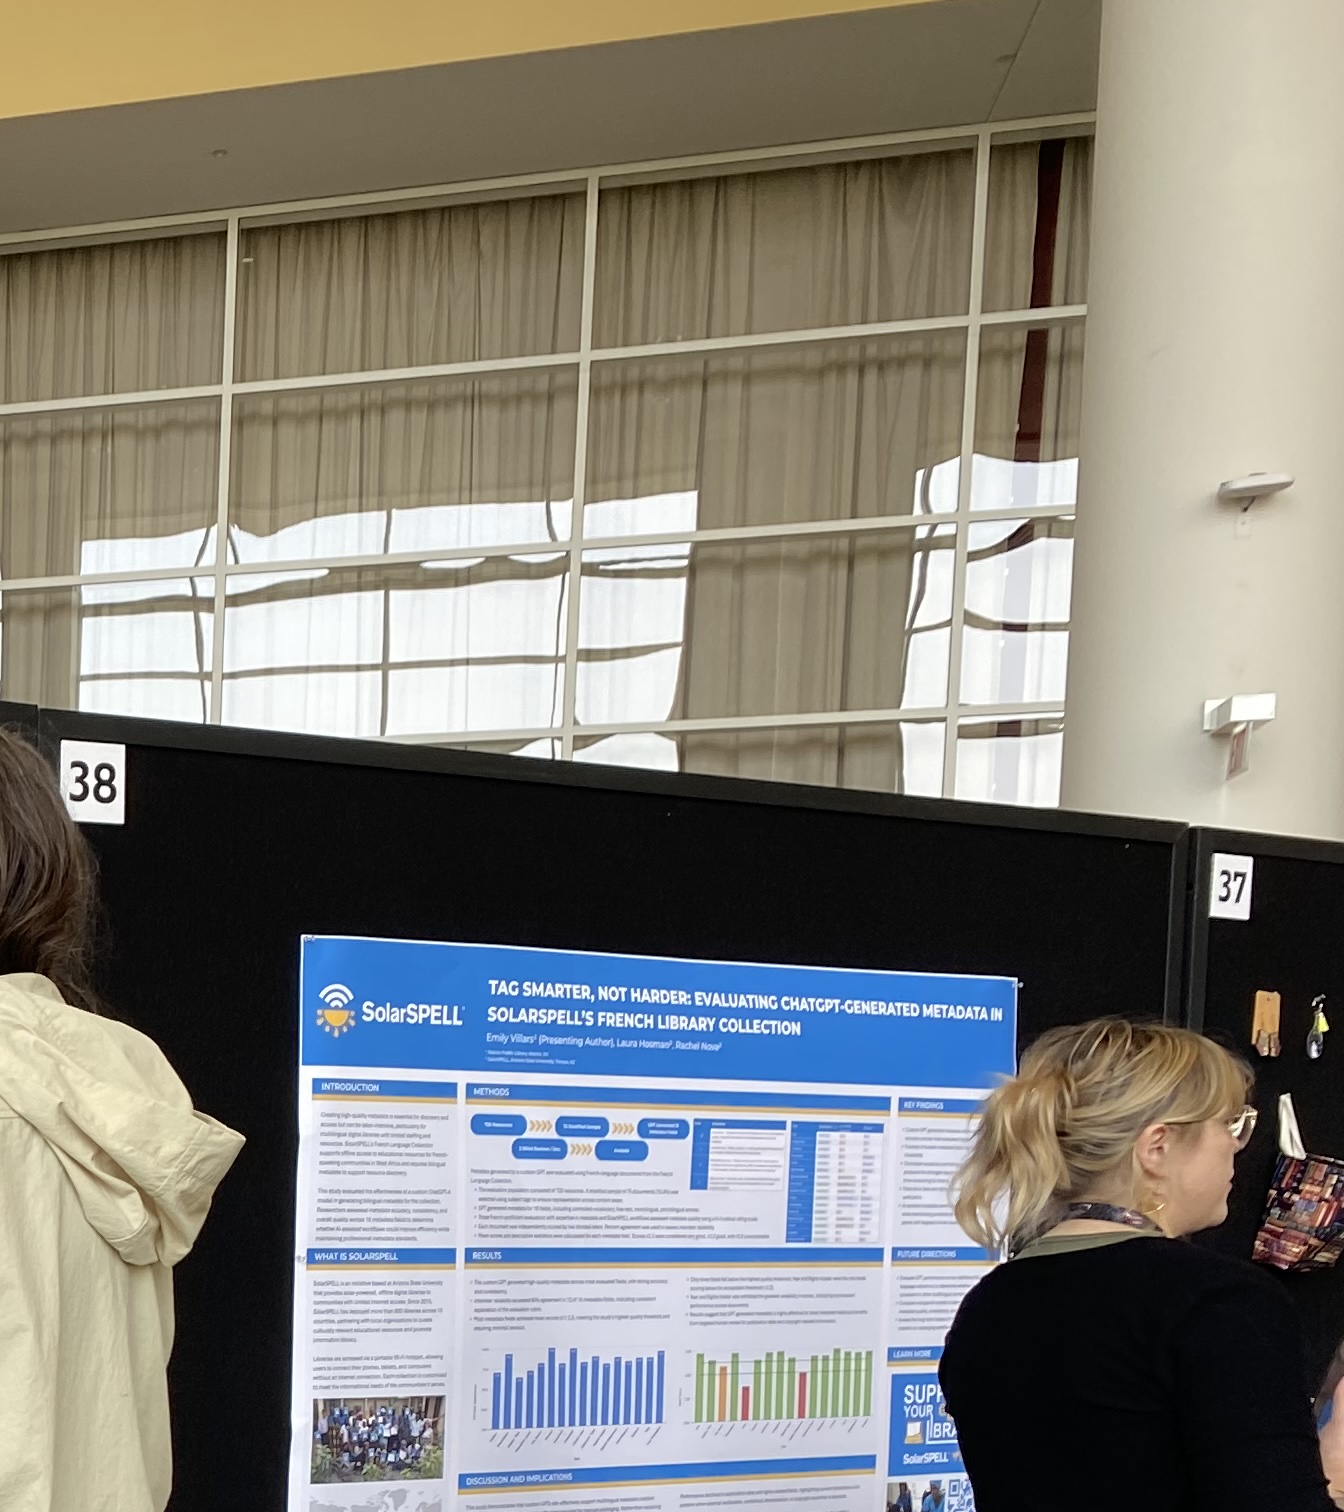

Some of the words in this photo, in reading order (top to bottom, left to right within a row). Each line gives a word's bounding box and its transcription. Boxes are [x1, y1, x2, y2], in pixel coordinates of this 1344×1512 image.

[69, 760, 117, 804] 38
[1218, 869, 1247, 904] 37
[488, 979, 518, 996] TAG
[522, 981, 594, 1002] SMARTER,
[598, 985, 626, 1002] NOT
[630, 987, 691, 1005] HARDER:
[694, 990, 777, 1010] EVALUATING
[780, 995, 919, 1017] CHATGPT-GENERATED
[922, 1002, 987, 1021] METADATA
[990, 1007, 1001, 1021] IN
[362, 999, 464, 1027] SolarSPELL
[487, 1006, 593, 1026] SOLARSPELL'S
[598, 1011, 653, 1028] FRENCH
[658, 1014, 715, 1031] LIBRARY
[719, 1017, 800, 1035] COLLECTION
[321, 1081, 379, 1092] INTRODUCTION
[473, 1086, 510, 1096] METHODS
[314, 1252, 337, 1260] WHAT
[340, 1252, 348, 1260] IS
[348, 1251, 397, 1260] SOLARSPELL
[472, 1251, 501, 1259] RESULTS
[904, 1404, 933, 1418] YOUR
[903, 1452, 949, 1465] SolarSPELL
[465, 1475, 508, 1485] DISCUSSION
[508, 1474, 526, 1483] AND
[526, 1472, 574, 1482] IMPLICATIONS
